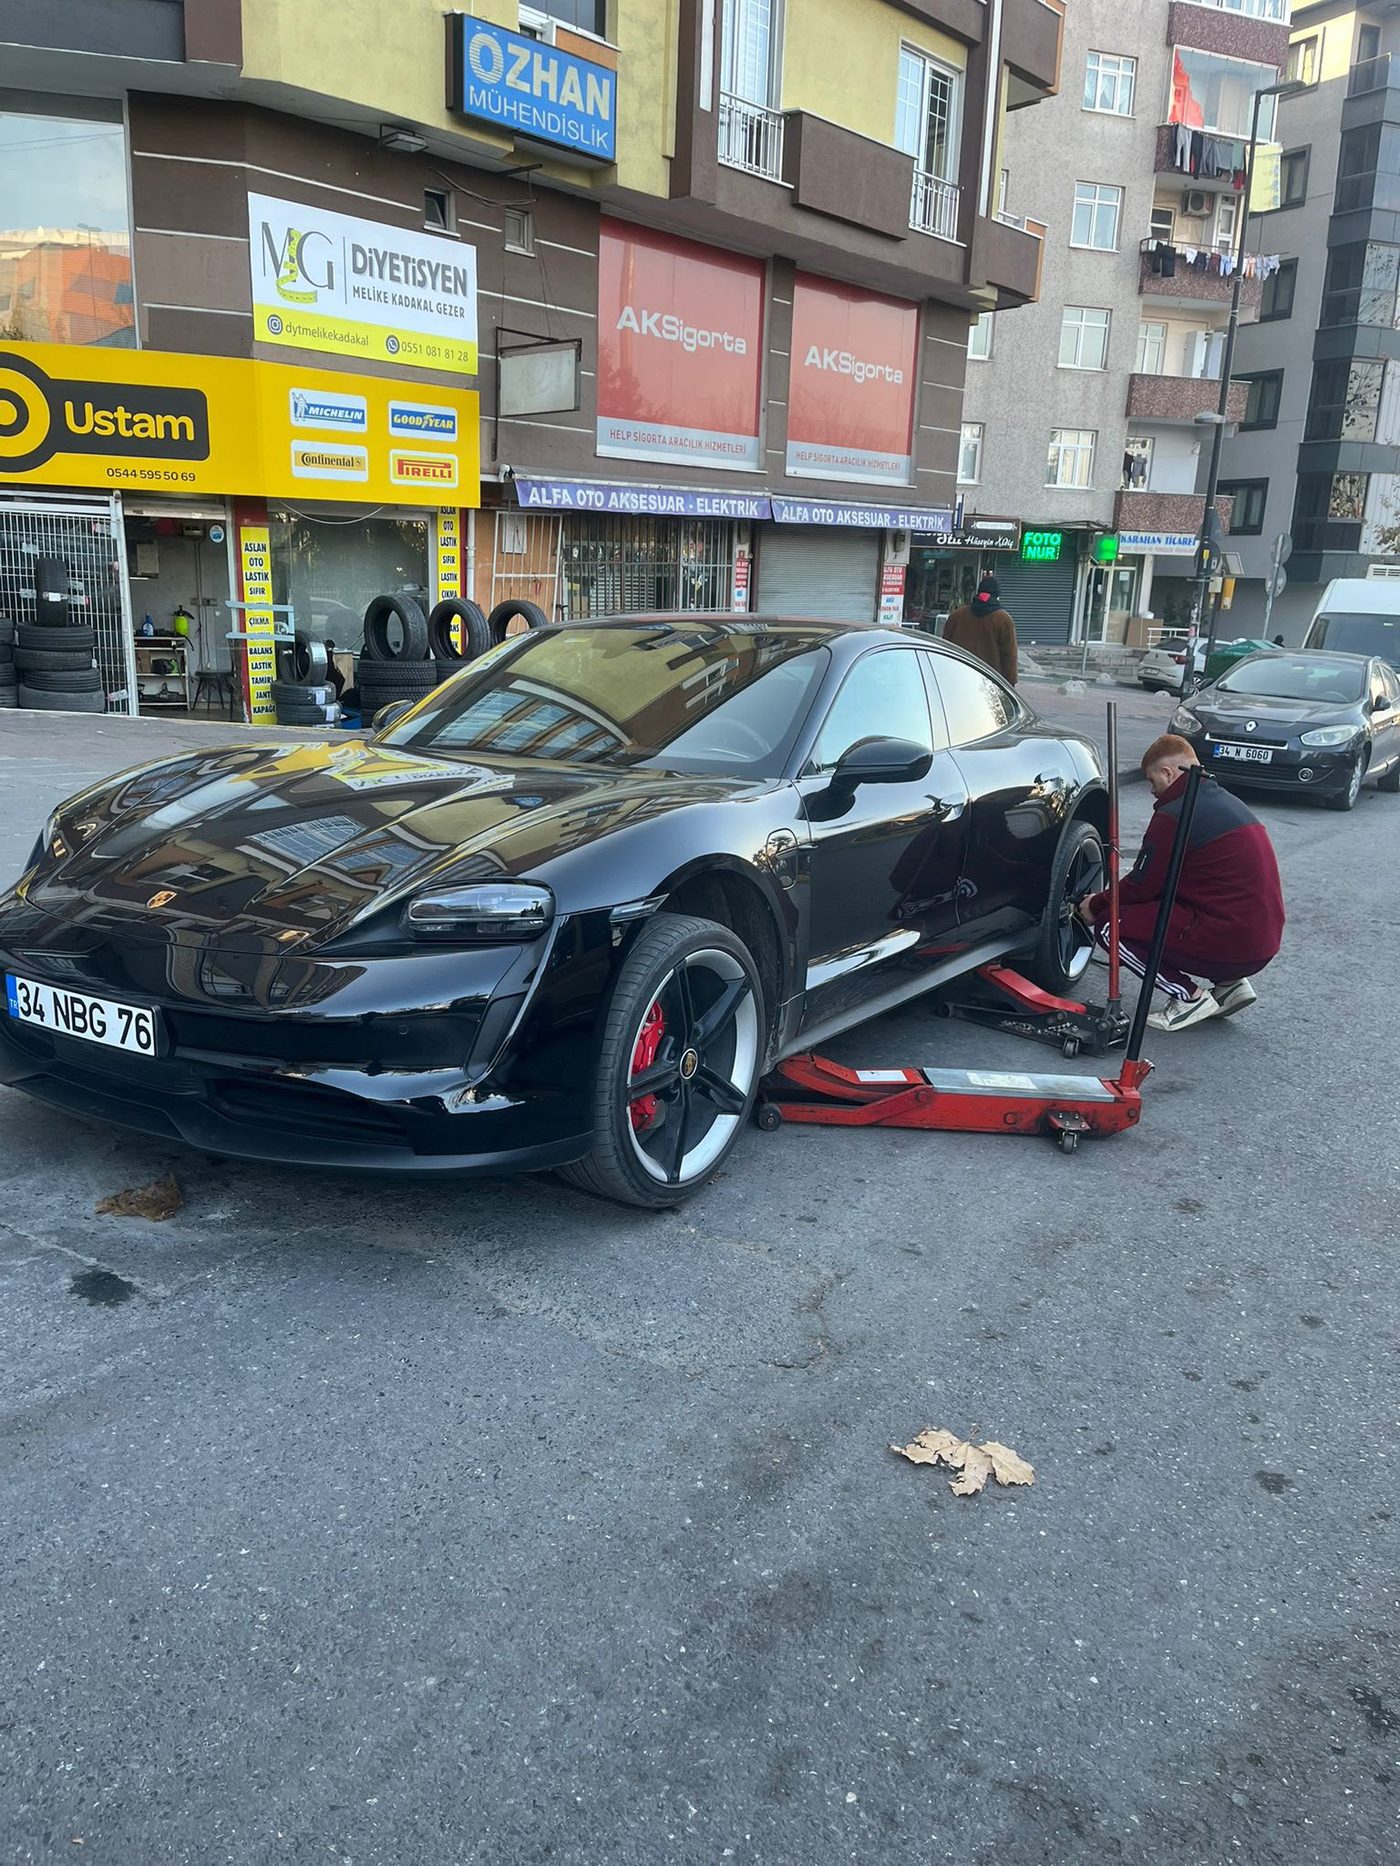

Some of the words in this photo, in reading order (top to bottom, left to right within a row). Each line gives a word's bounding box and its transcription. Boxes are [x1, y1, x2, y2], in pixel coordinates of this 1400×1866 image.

[469, 25, 610, 120] ÖZHAN
[469, 85, 609, 150] MÜHENDİSLİK
[352, 285, 389, 304] MELİKE
[391, 293, 434, 313] KADAKAL
[436, 304, 465, 319] GEZER
[285, 322, 369, 346] dytmelikekadakal
[616, 306, 746, 355] AKSigorta
[401, 342, 423, 355] 0551
[425, 345, 442, 357] 081
[444, 348, 455, 359] 81
[457, 350, 469, 361] 28
[804, 345, 903, 384] AKSigorta
[64, 400, 195, 441] Ustam
[308, 406, 363, 420] MICHELIN
[610, 429, 631, 441] HELP
[668, 437, 703, 449] ARACILIK
[301, 452, 355, 467] Continental
[796, 451, 812, 461] HELP
[106, 467, 137, 479] 0544
[139, 469, 161, 480] 595
[163, 470, 179, 481] 50
[181, 471, 196, 482] 69
[397, 458, 452, 479] PIRELLI
[528, 486, 573, 506] ALFA
[576, 489, 605, 507] OTO
[608, 491, 684, 512] AKSESUAR
[697, 497, 758, 516] ELEKTRİK
[440, 506, 456, 515] ASLAN
[782, 506, 809, 521] ALFA
[812, 508, 834, 523] OTO
[837, 510, 890, 527] AKSESUAR
[898, 514, 944, 530] ELEKTRİK
[443, 520, 454, 531] OTO
[1024, 531, 1062, 545] FOTO
[1120, 534, 1162, 545] KARAHAN
[244, 543, 266, 552] ASLAN
[1026, 546, 1057, 559] NUR
[249, 557, 263, 567] OTO
[442, 555, 455, 564] SIFIR
[249, 587, 265, 595] SIFIR
[249, 617, 269, 627] ÇIKMA
[249, 647, 273, 655] BALANS
[1219, 745, 1230, 756] 34
[1234, 747, 1241, 757] N
[1245, 748, 1269, 760] 6060
[9, 998, 19, 1010] TR
[18, 982, 45, 1022] 34
[53, 991, 107, 1038] NBG
[117, 1007, 152, 1050] 76
